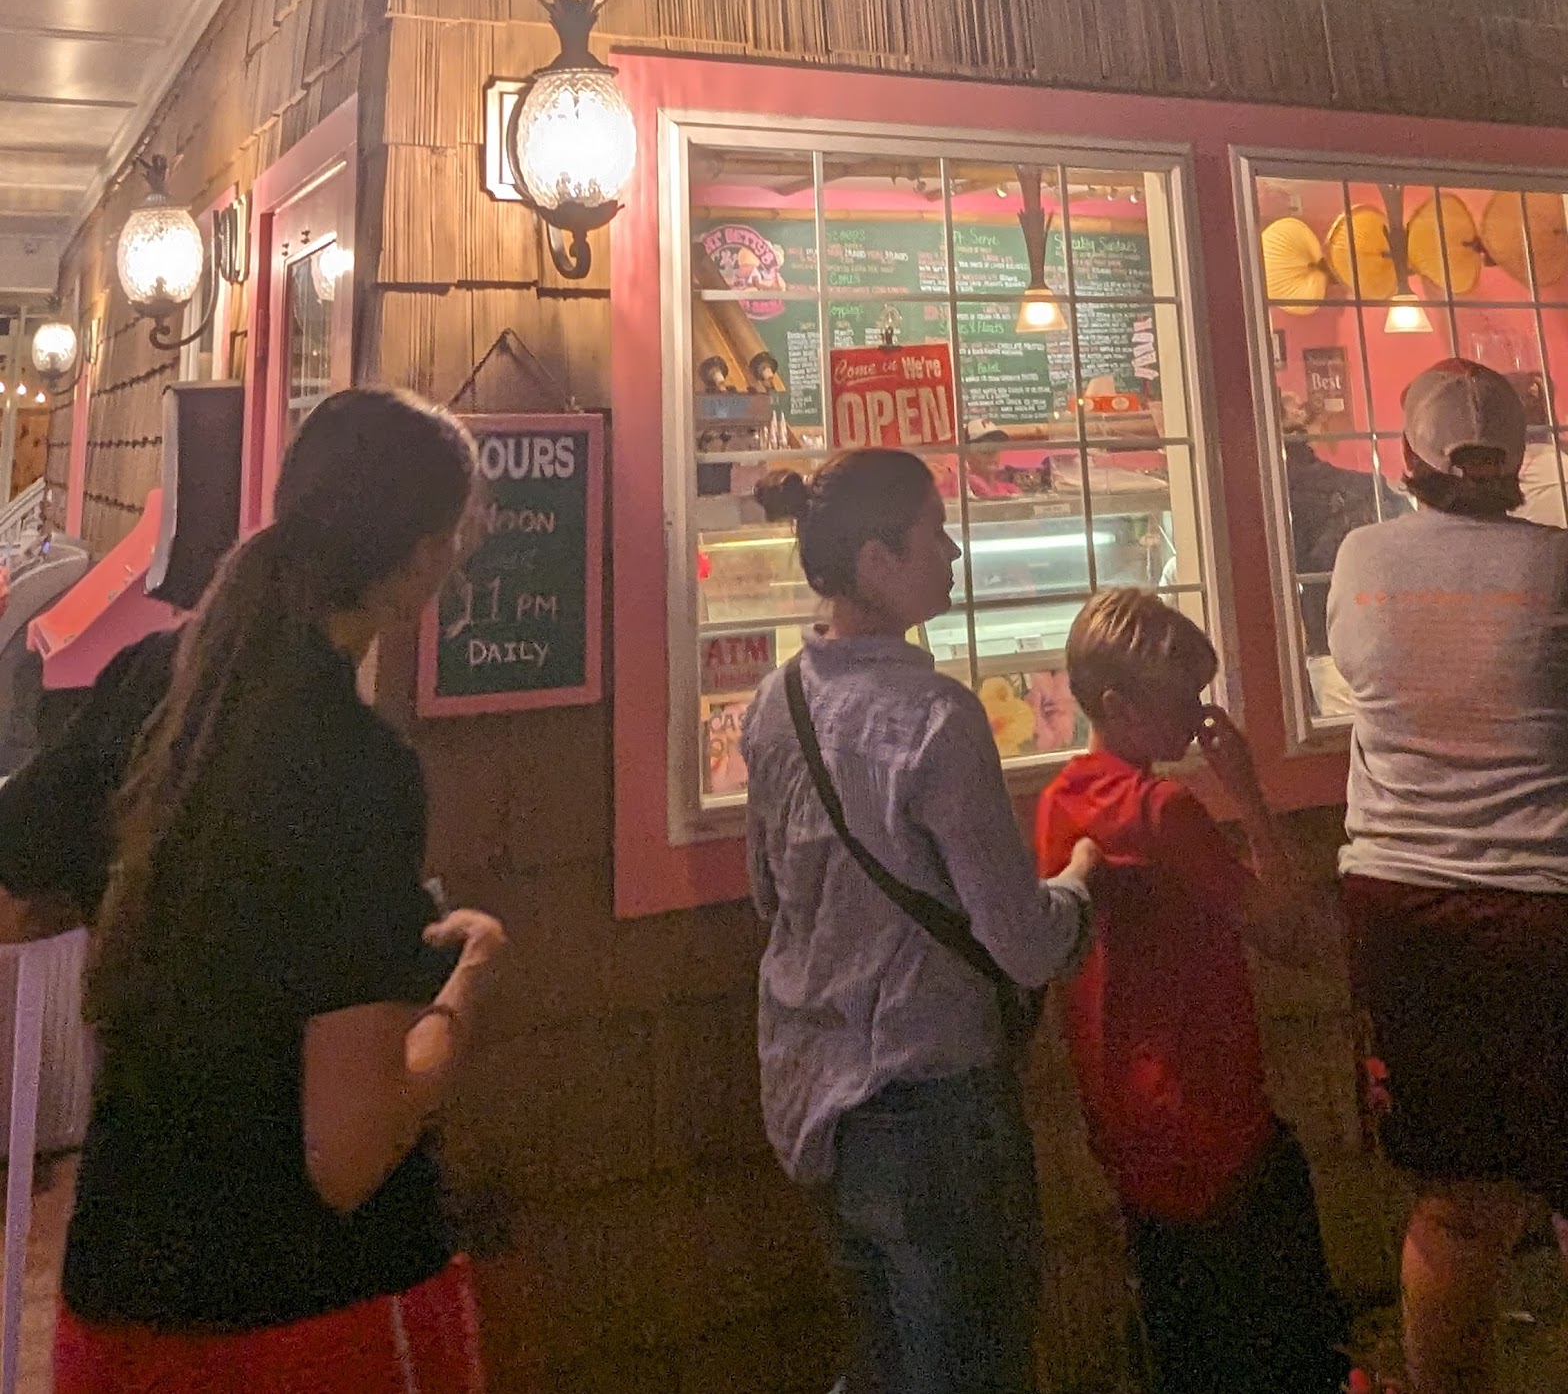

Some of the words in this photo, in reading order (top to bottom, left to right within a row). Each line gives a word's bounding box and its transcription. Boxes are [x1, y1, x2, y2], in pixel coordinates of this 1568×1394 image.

[834, 358, 876, 385] Come
[902, 356, 942, 381] We're
[1311, 372, 1342, 391] Best
[836, 385, 953, 449] OPEN
[479, 435, 575, 481] OURS
[516, 592, 558, 621] PM
[469, 639, 550, 668] DAILY
[706, 633, 769, 667] ATM
